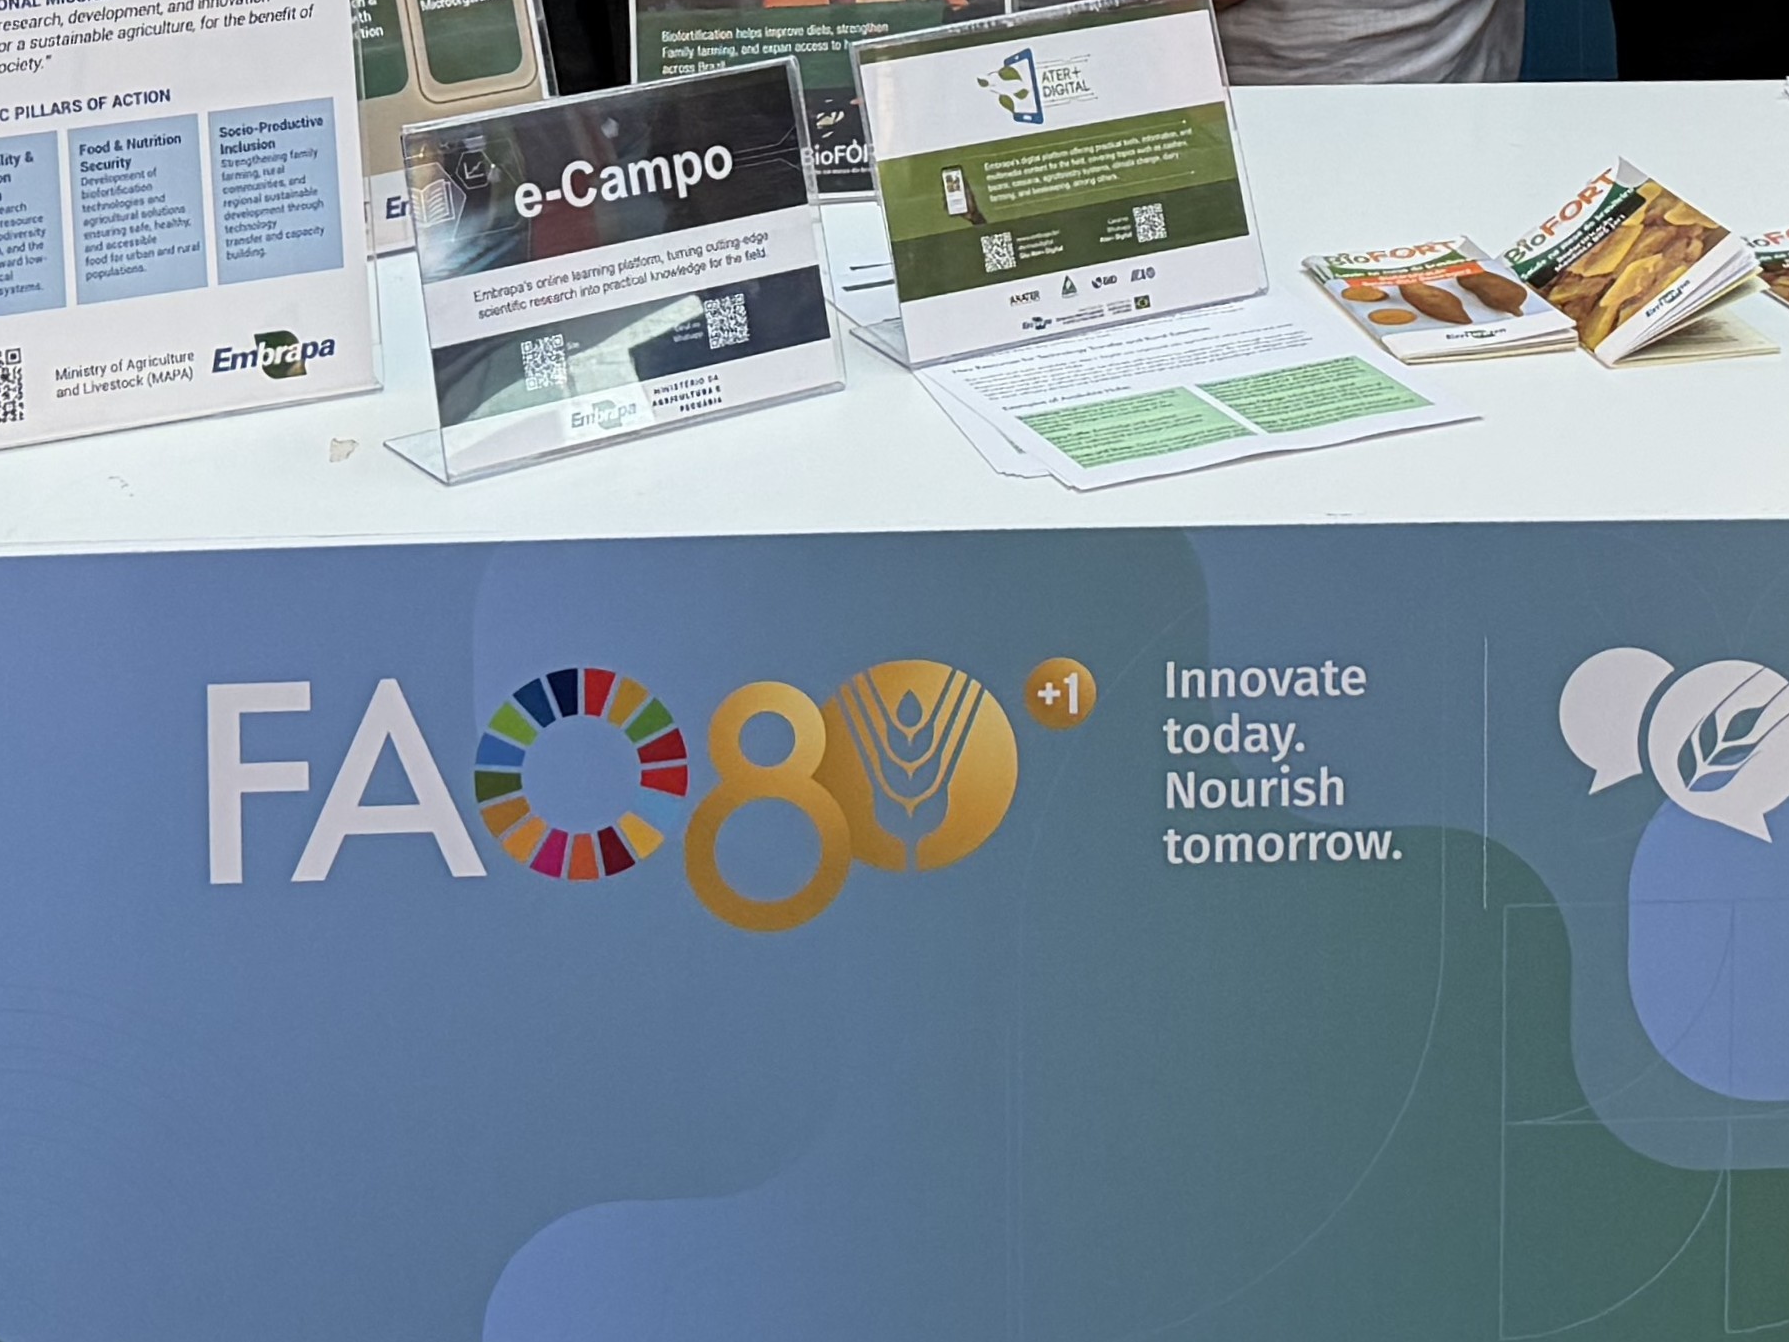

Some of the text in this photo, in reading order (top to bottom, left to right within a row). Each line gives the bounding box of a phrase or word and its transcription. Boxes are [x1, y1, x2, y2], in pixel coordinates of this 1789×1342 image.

[17, 39, 25, 51] a
[30, 28, 113, 50] sustainable
[117, 19, 197, 41] agriculture,
[199, 14, 219, 30] for
[223, 11, 245, 27] the
[248, 6, 296, 25] benefit
[300, 4, 314, 19] of
[68, 3, 164, 25] development,
[1041, 66, 1081, 84] ATER+
[1042, 79, 1091, 98] DIGITAL
[15, 100, 83, 120] PILLARS
[87, 97, 108, 110] OF
[112, 89, 171, 109] ACTION
[220, 116, 323, 138] Socio-Productive
[25, 151, 34, 163] &
[79, 134, 181, 155] Food & Nutrition
[220, 139, 275, 154] Inclusion
[80, 157, 131, 173] Security
[514, 144, 734, 218] e-Campo
[1504, 167, 1614, 265] BioFORT
[1325, 240, 1456, 267] BioFORT
[56, 350, 195, 382] Ministry of Agriculture
[212, 335, 335, 374] Embrapa
[56, 367, 194, 399] and Livestock (MAPA)
[571, 401, 637, 429] Embrapa
[1036, 672, 1081, 716] +1
[1163, 659, 1367, 701] Innovate
[1163, 713, 1305, 761] today.
[1164, 765, 1345, 810] Nourish
[1162, 825, 1404, 865] tomorrow.
